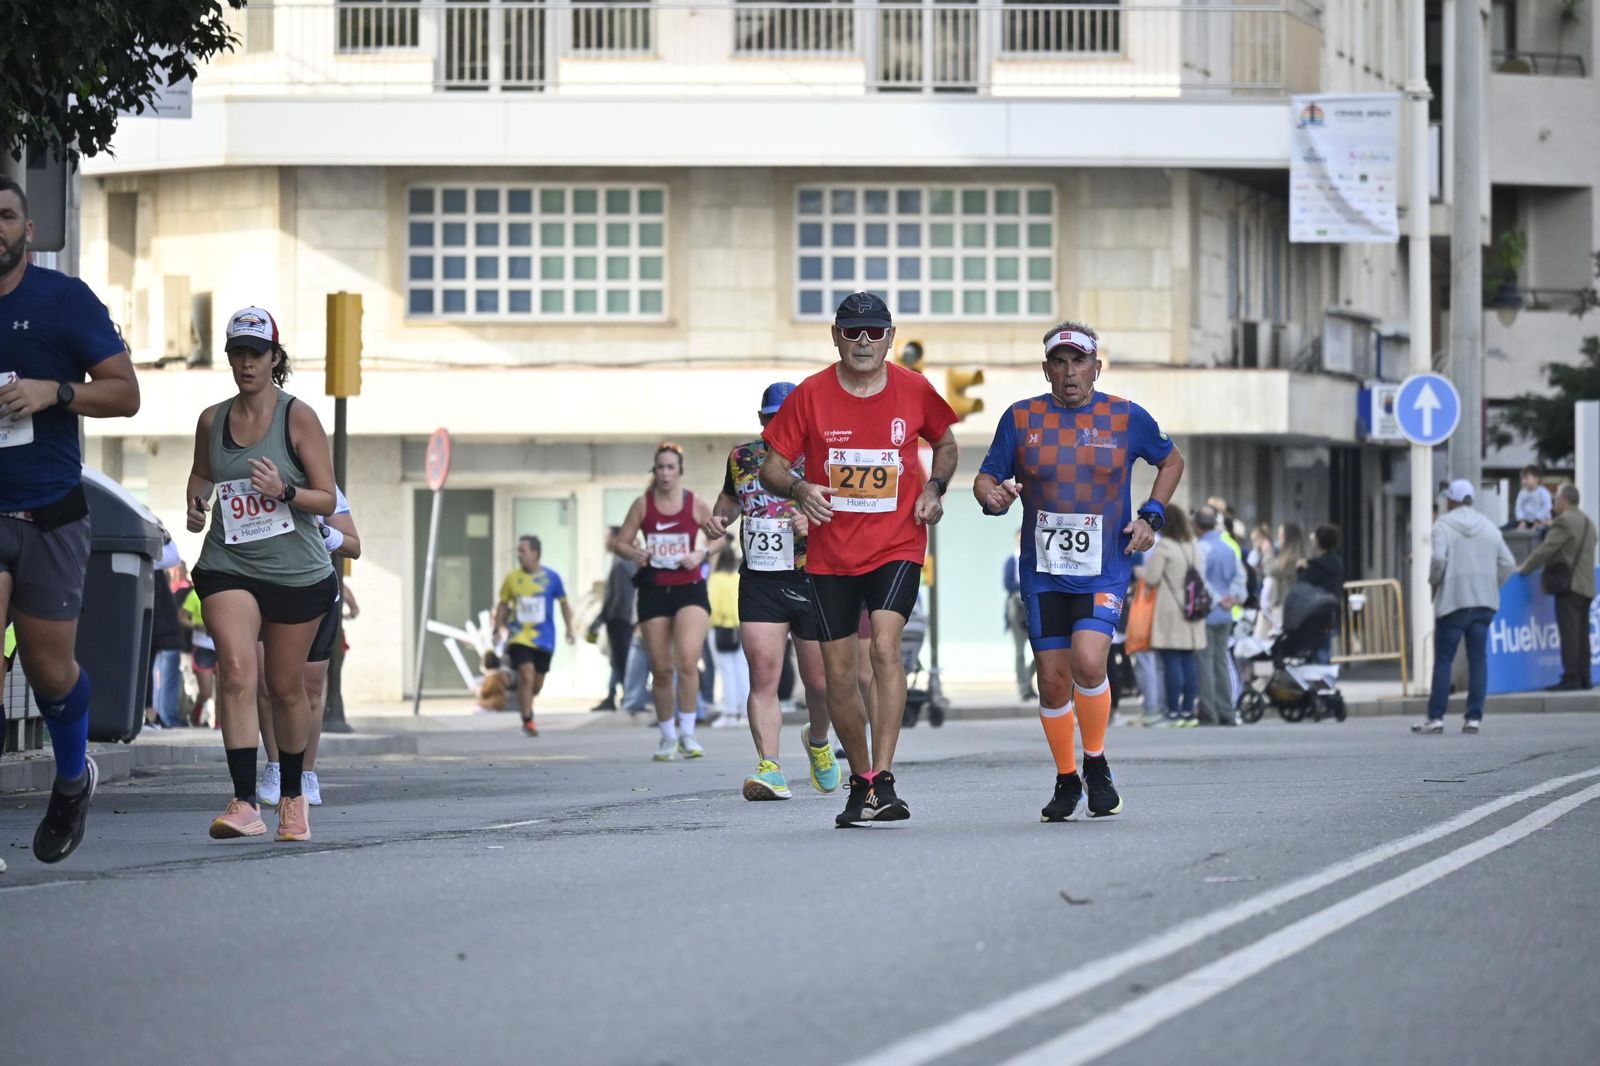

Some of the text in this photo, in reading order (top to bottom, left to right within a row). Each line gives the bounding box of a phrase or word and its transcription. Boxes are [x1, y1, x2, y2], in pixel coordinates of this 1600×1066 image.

[834, 451, 846, 461] 2K
[881, 451, 895, 462] 2K
[839, 465, 888, 490] 279
[220, 483, 235, 494] 2K
[230, 494, 276, 520] 906
[847, 498, 877, 507] Huelva
[1040, 512, 1049, 524] 2K
[1084, 516, 1098, 527] 2K
[241, 525, 271, 536] Huelva
[747, 531, 784, 552] 733
[1042, 529, 1090, 553] 739
[751, 559, 776, 567] Huelva
[1049, 560, 1079, 570] Huelva
[1489, 615, 1561, 654] Huelva
